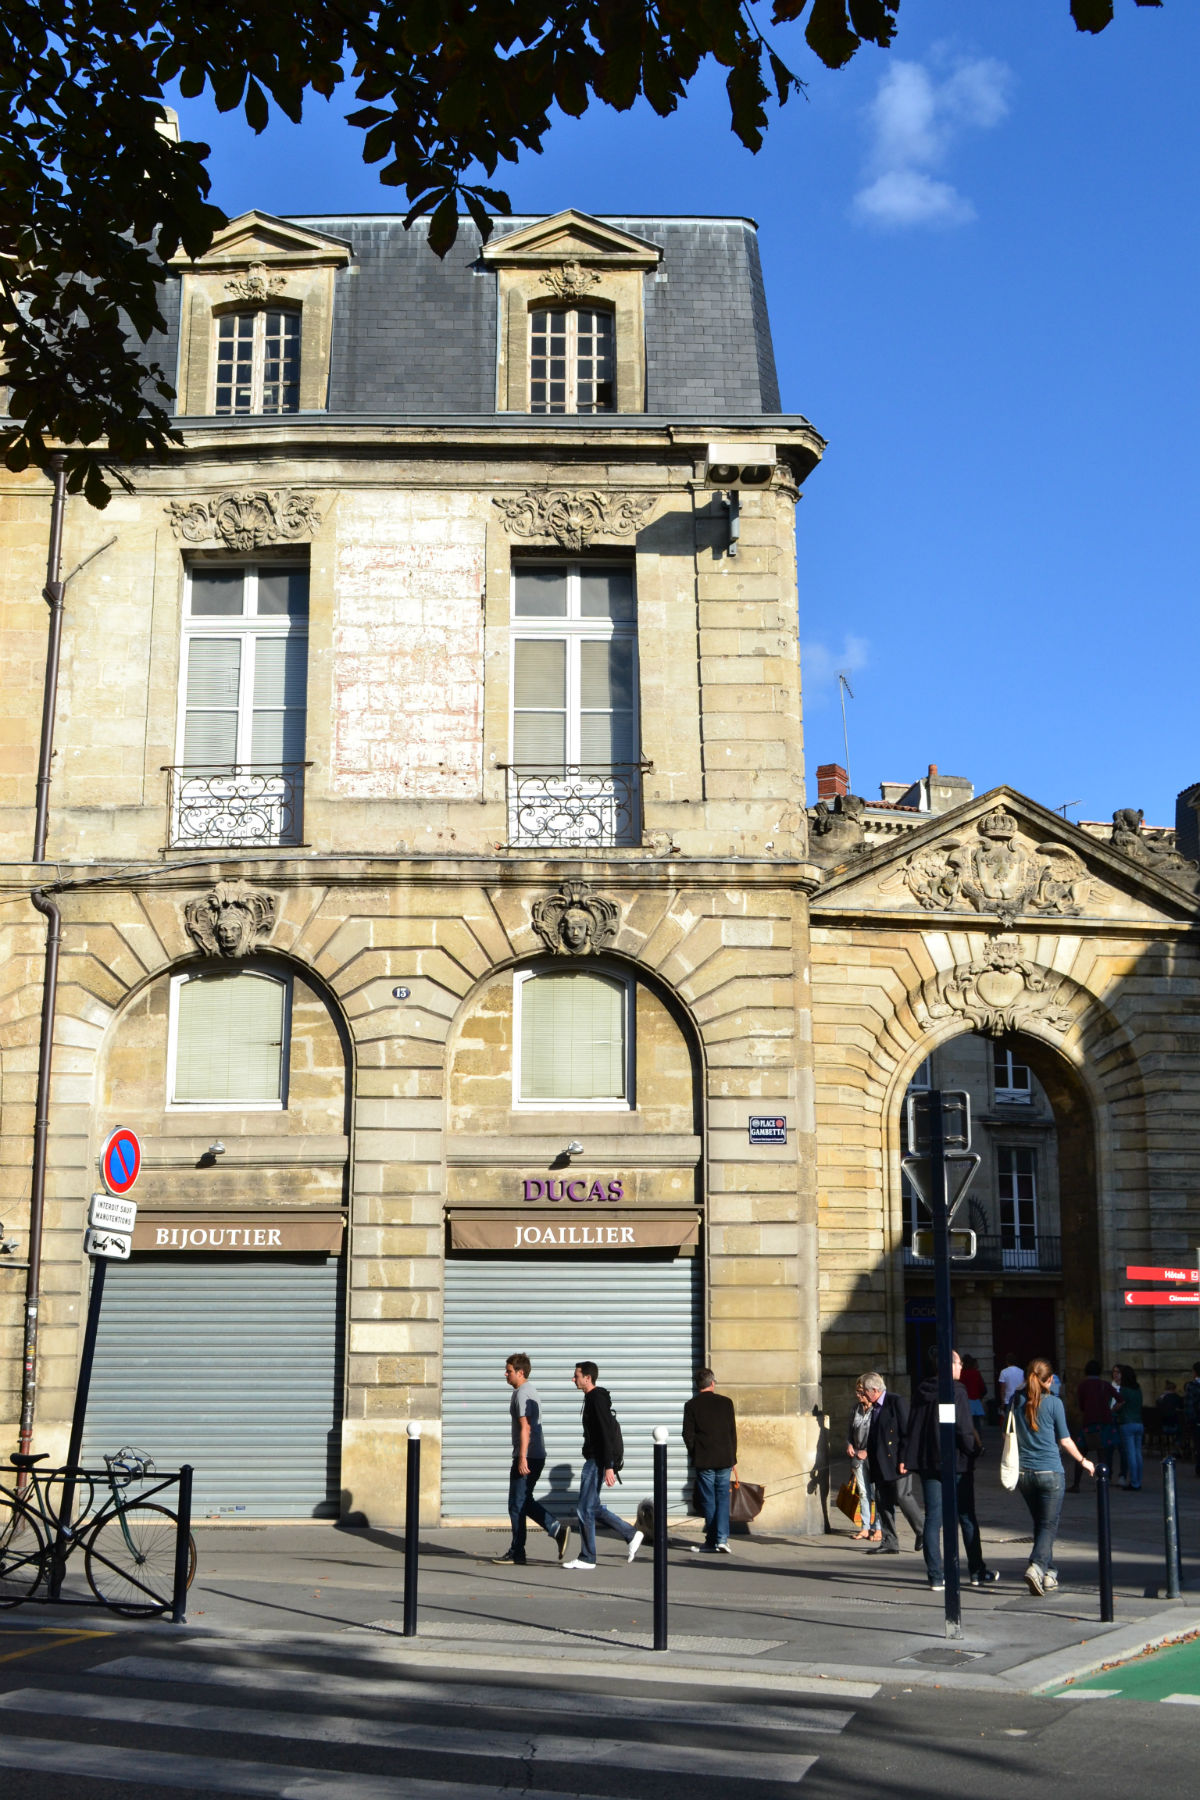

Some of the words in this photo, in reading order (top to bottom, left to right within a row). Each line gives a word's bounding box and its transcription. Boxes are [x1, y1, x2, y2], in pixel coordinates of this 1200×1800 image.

[396, 988, 407, 997] 13
[523, 1180, 624, 1202] DUCAS
[97, 1202, 119, 1211] INTERDIT
[120, 1206, 132, 1214] SAUF
[95, 1212, 132, 1225] MANUTENTIONS
[156, 1228, 282, 1249] BIJOUTIER
[514, 1226, 636, 1248] JOAILLIER
